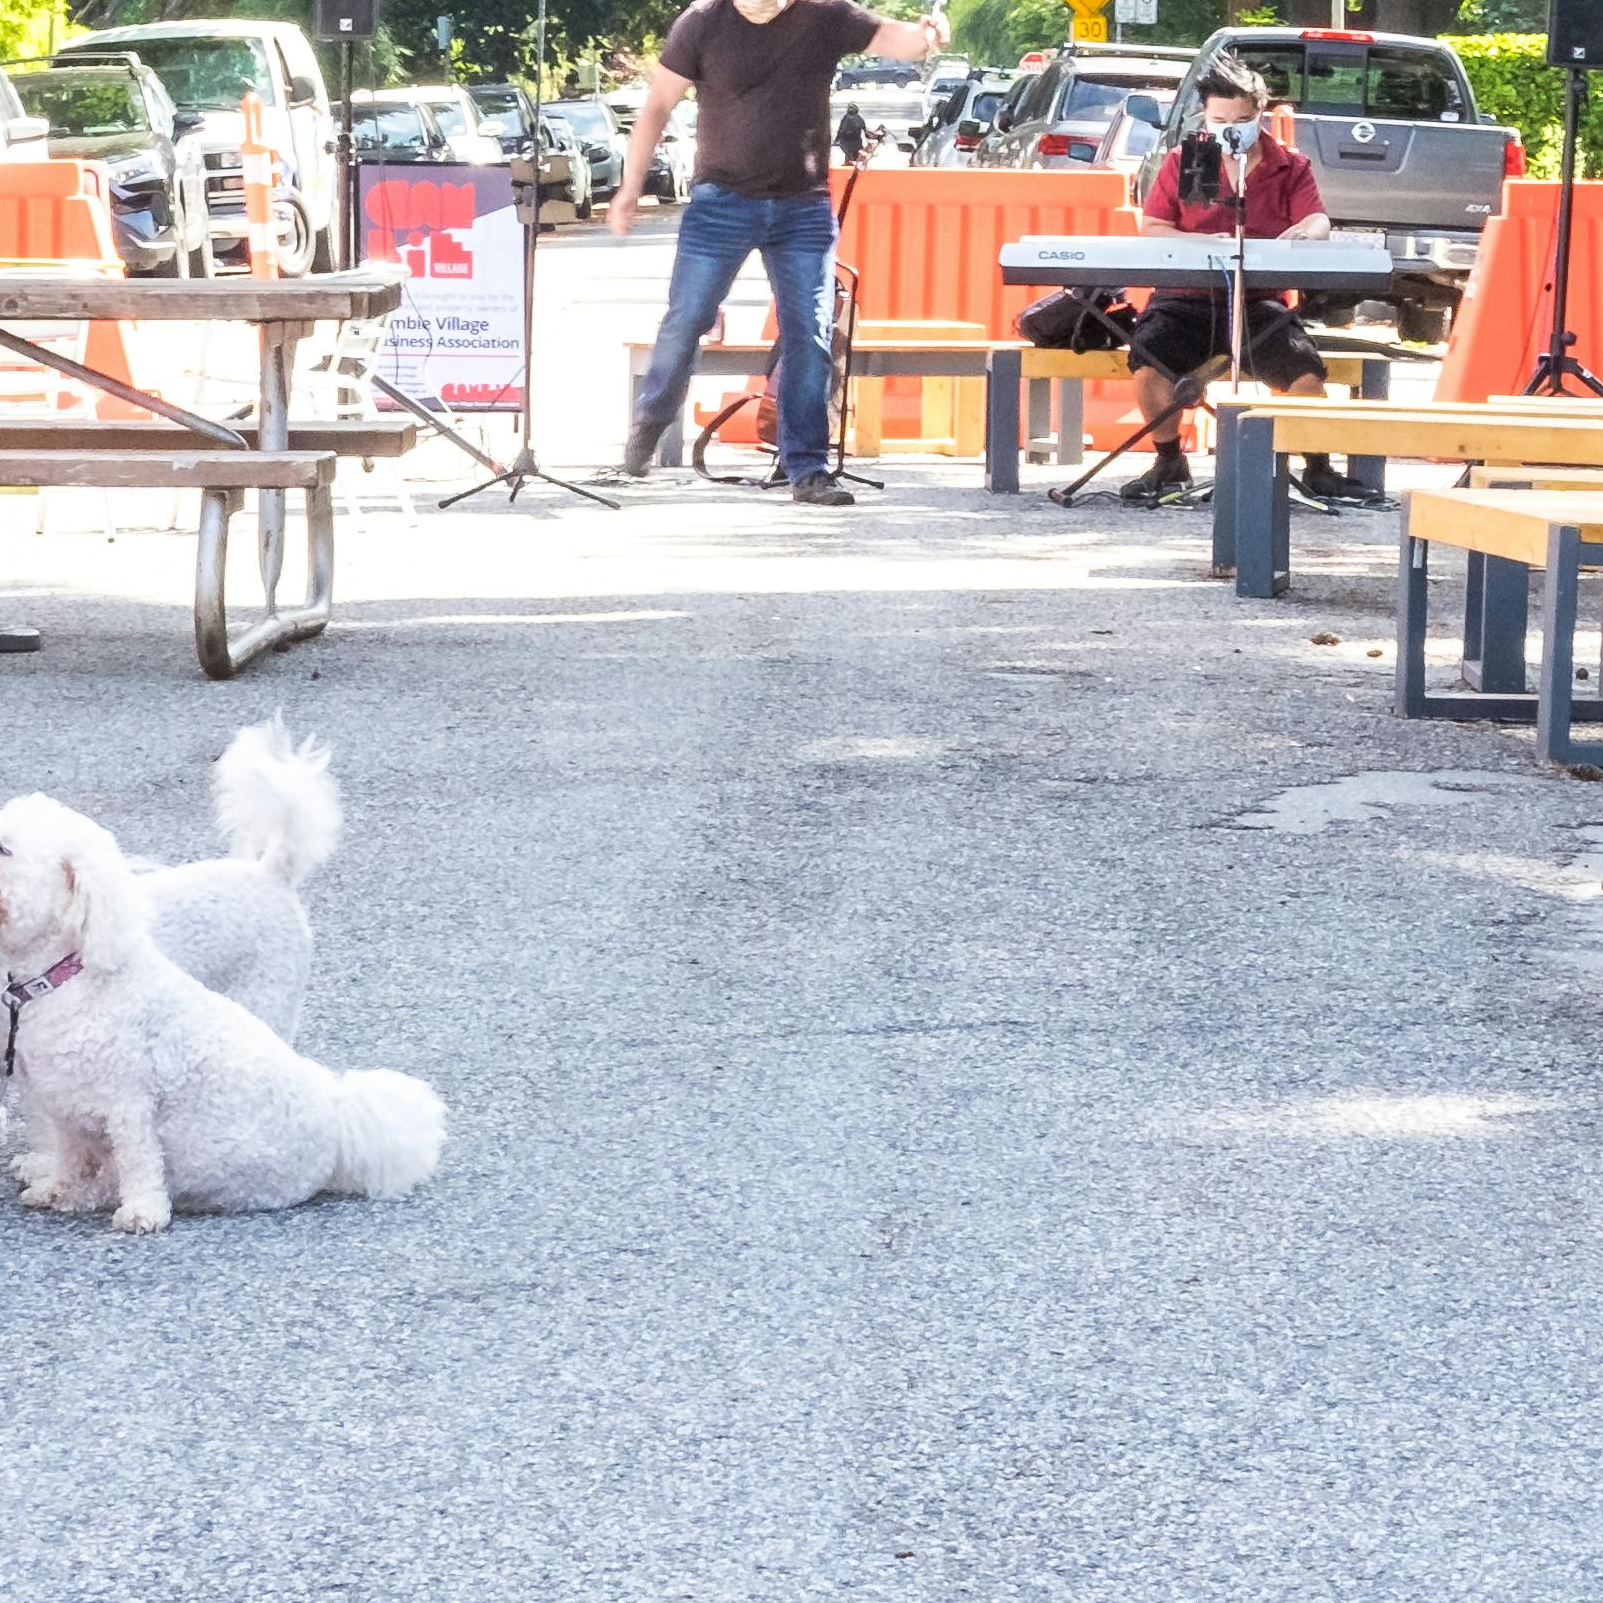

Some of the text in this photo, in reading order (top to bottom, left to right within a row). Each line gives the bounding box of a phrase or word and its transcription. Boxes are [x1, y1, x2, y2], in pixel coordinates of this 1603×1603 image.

[1079, 22, 1102, 38] 30
[1021, 61, 1043, 74] STO
[1037, 250, 1085, 261] CASIO
[390, 316, 490, 335] mbie Village
[436, 336, 520, 350] Association
